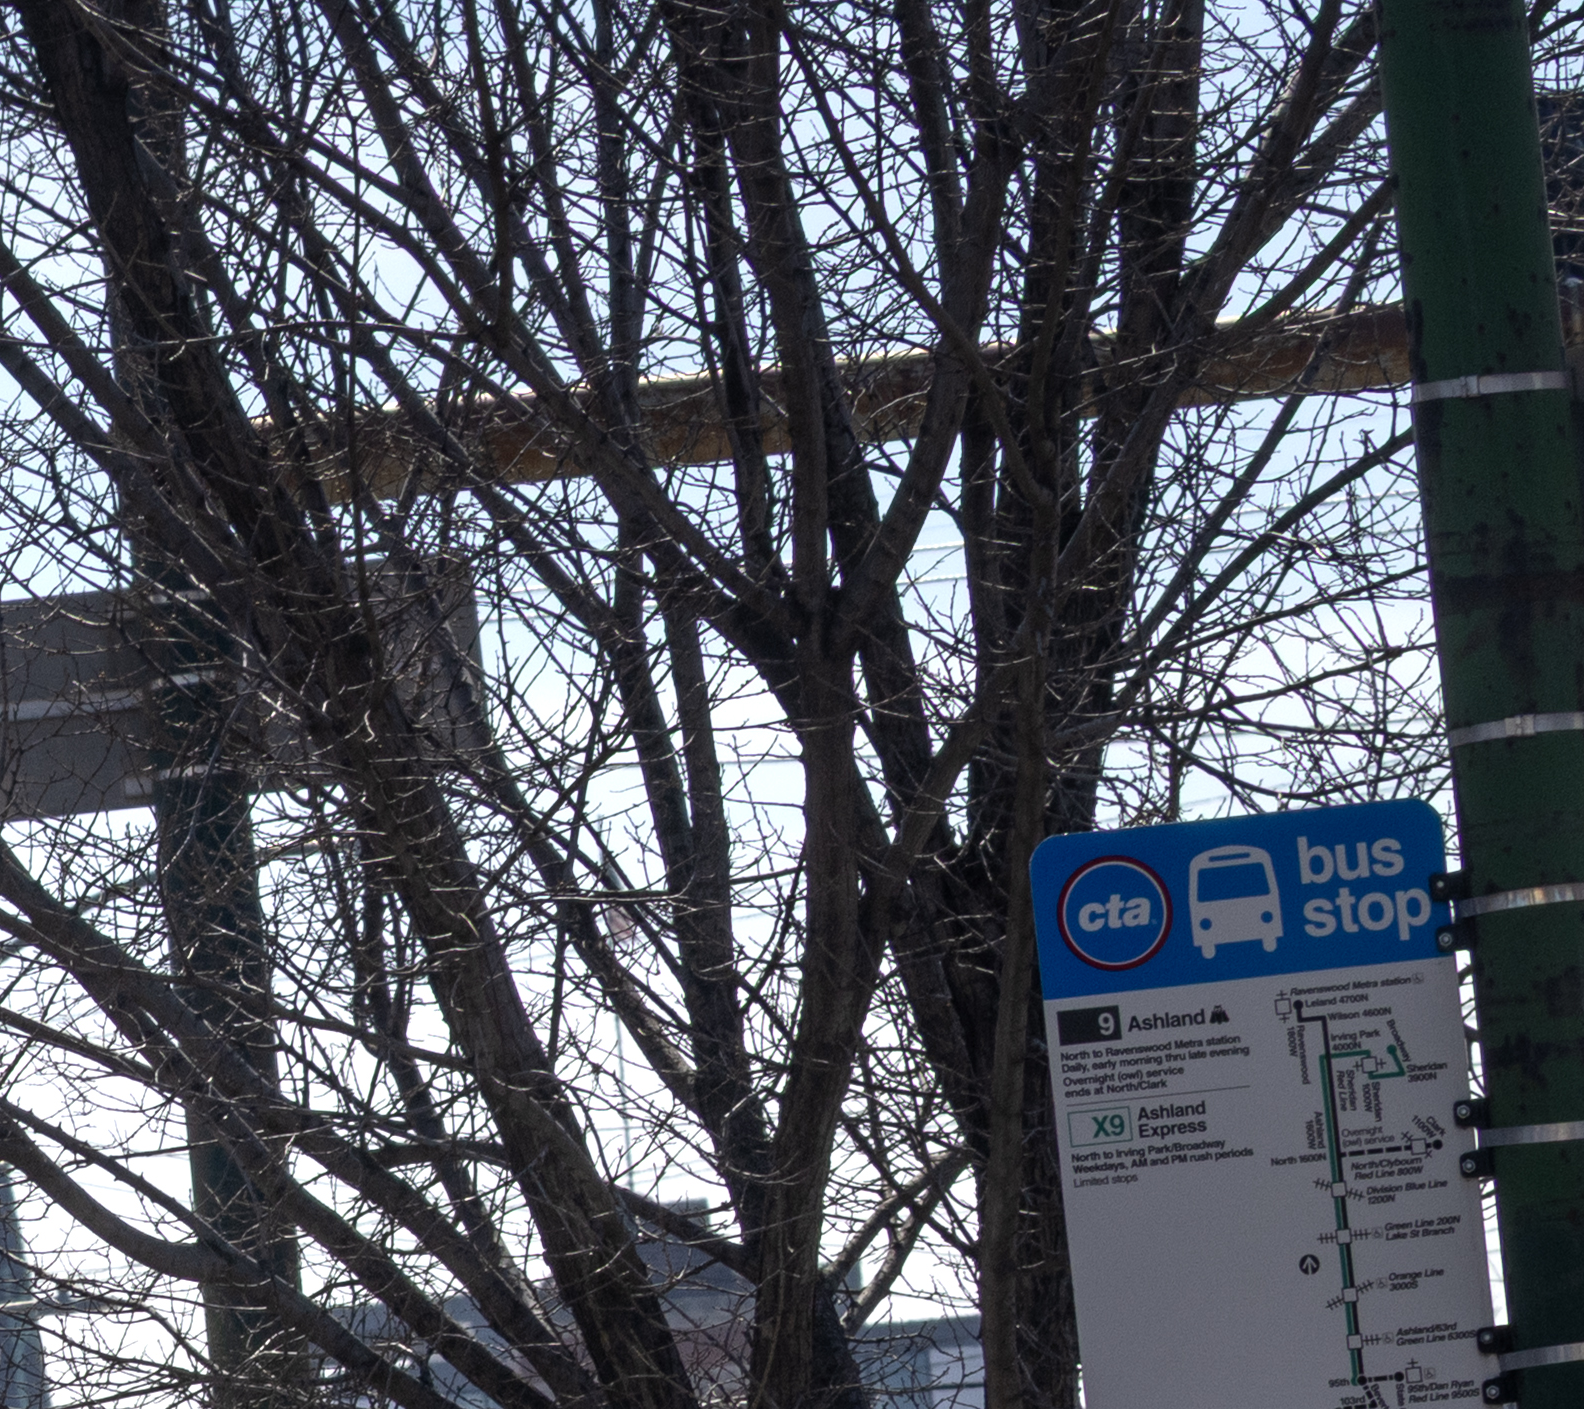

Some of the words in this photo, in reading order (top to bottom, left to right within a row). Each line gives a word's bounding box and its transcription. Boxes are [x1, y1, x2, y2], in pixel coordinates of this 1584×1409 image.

[1297, 836, 1404, 884] bus
[1078, 894, 1151, 932] cta
[1303, 886, 1432, 941] stop
[1290, 982, 1350, 996] Ravenswood
[1352, 980, 1378, 990] Metra
[1380, 976, 1411, 987] station
[1305, 997, 1337, 1008] Leland
[1098, 1012, 1115, 1036] 9
[1127, 1009, 1206, 1032] Ashland
[1327, 1011, 1360, 1021] Wilson
[1362, 1007, 1392, 1017] 4600N
[1287, 1026, 1298, 1057] 1800W
[1331, 1032, 1357, 1042] Irving
[1359, 1029, 1381, 1039] Park
[1387, 1019, 1411, 1063] Broadway
[1060, 1050, 1090, 1062] North
[1093, 1049, 1103, 1059] to
[1106, 1041, 1172, 1057] Ravenswood
[1175, 1038, 1203, 1049] Metra
[1206, 1035, 1241, 1046] station
[1298, 1025, 1311, 1085] Ravenswood
[1332, 1041, 1361, 1051] 4000N
[1062, 1062, 1090, 1075] Daily,
[1093, 1059, 1116, 1071] early
[1120, 1054, 1162, 1068] morning
[1165, 1051, 1186, 1062] thru
[1189, 1048, 1207, 1060] late
[1209, 1046, 1250, 1058] evening
[1406, 1062, 1447, 1073] Sheridan
[1063, 1073, 1115, 1087] Overnight
[1118, 1070, 1143, 1083] (owl)
[1146, 1067, 1184, 1079] service
[1065, 1087, 1091, 1099] ends
[1094, 1086, 1104, 1096] at
[1107, 1079, 1167, 1094] North/Clark
[1347, 1070, 1357, 1111] Sheridan
[1137, 1101, 1206, 1121] Ashland
[1372, 1082, 1382, 1122] Sheridan
[1092, 1114, 1125, 1138] X9
[1139, 1120, 1207, 1139] Express
[1305, 1120, 1316, 1150] 1600W
[1314, 1111, 1326, 1149] Ashland
[1342, 1126, 1383, 1137] Overnight
[1425, 1116, 1446, 1138] Clark
[1364, 1134, 1395, 1144] service
[1072, 1152, 1101, 1163] North
[1103, 1150, 1113, 1160] to
[1116, 1146, 1145, 1159] Irving
[1148, 1139, 1225, 1155] Park/Broadway
[1073, 1160, 1128, 1174] Weekdays,
[1131, 1157, 1148, 1168] AM
[1150, 1155, 1169, 1166] and
[1171, 1153, 1188, 1163] PM
[1189, 1150, 1212, 1161] rush
[1215, 1147, 1254, 1161] periods
[1271, 1156, 1296, 1166] North
[1351, 1157, 1422, 1171] North/Clybourn
[1074, 1176, 1109, 1188] Limited
[1112, 1173, 1138, 1185] stops
[1355, 1171, 1373, 1180] Red
[1375, 1169, 1395, 1178] Line
[1367, 1183, 1403, 1195] Division
[1405, 1181, 1426, 1191] Blue
[1428, 1179, 1448, 1189] Line
[1385, 1222, 1412, 1232] Green
[1415, 1218, 1434, 1228] Line
[1386, 1231, 1407, 1241] Lake
[1410, 1230, 1420, 1238] St
[1422, 1227, 1455, 1237] Branch
[1389, 1270, 1422, 1281] Orange
[1424, 1268, 1444, 1277] Line
[1396, 1335, 1424, 1346] Green
[1426, 1333, 1445, 1343] Line
[1451, 1379, 1474, 1390] Ryan
[1409, 1393, 1427, 1403] Red
[1429, 1391, 1449, 1401] Line
